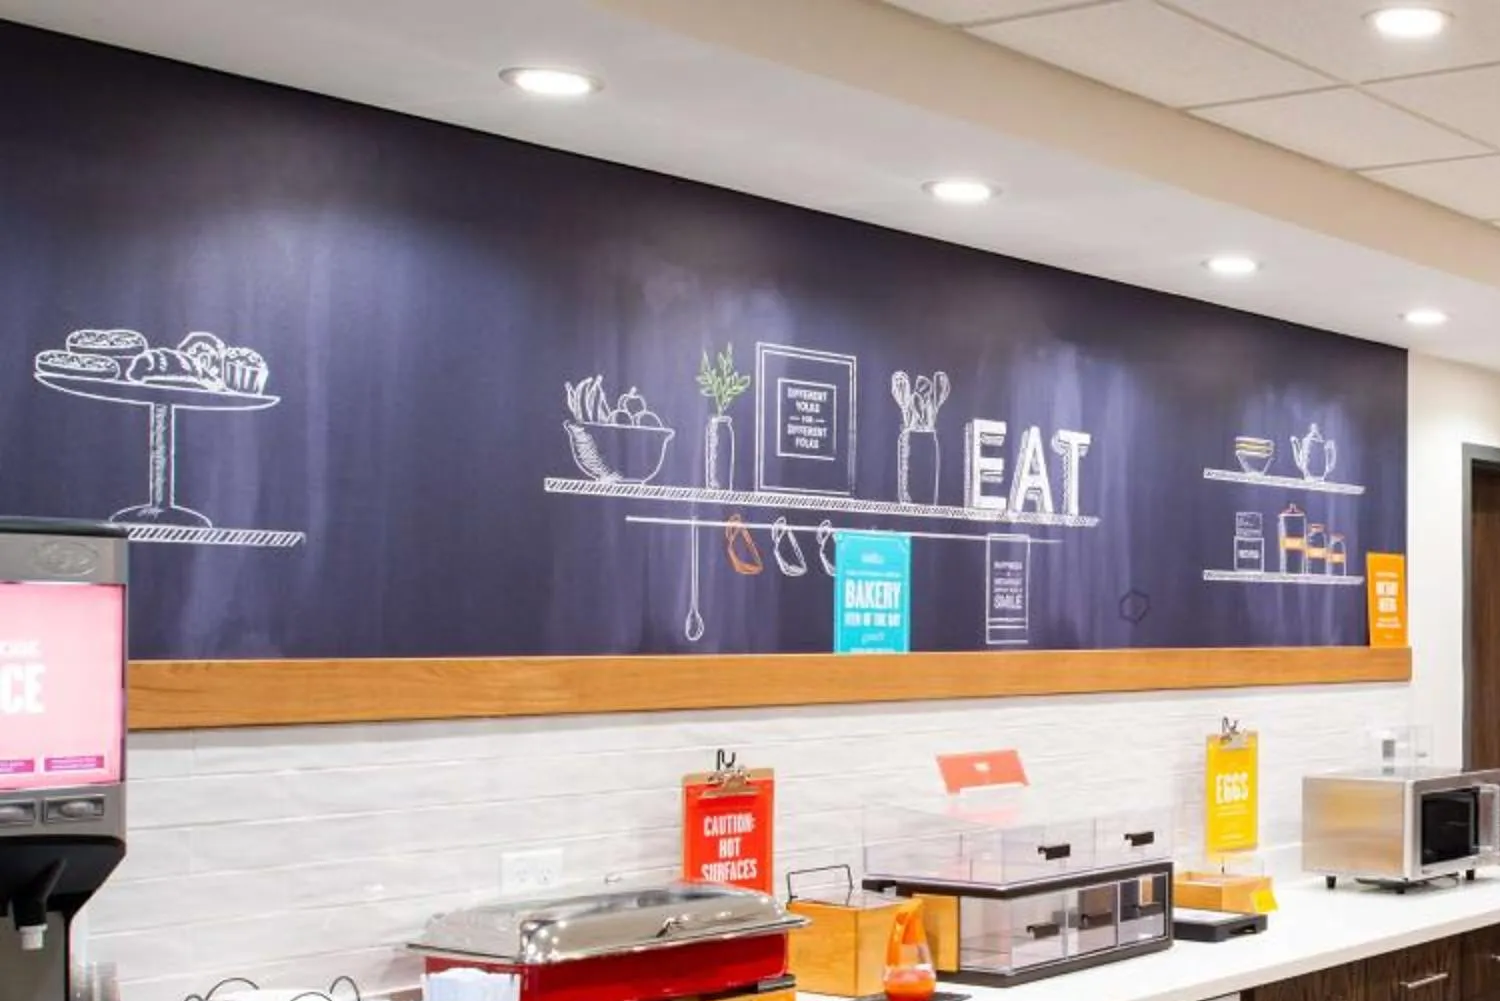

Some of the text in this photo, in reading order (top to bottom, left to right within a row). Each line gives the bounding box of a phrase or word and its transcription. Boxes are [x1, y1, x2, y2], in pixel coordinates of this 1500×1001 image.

[963, 418, 1091, 516] EAT
[845, 578, 901, 610] BAKERY
[1215, 772, 1249, 805] EGGS
[718, 837, 741, 859] HOT
[701, 858, 758, 882] SURFACES
